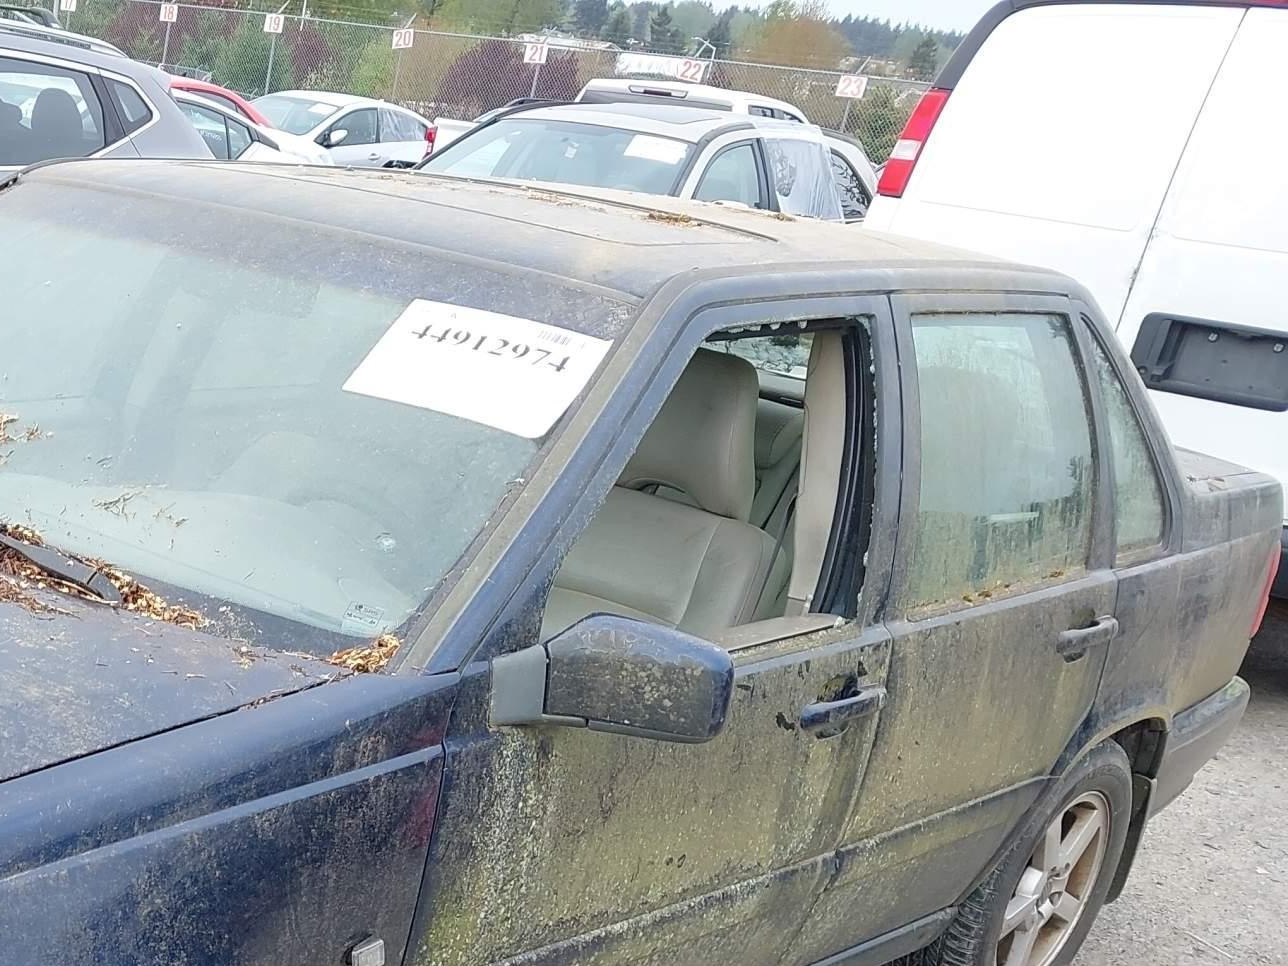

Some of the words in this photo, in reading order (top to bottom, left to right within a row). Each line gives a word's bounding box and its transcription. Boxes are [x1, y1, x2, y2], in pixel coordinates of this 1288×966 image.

[162, 5, 175, 19] 18
[268, 16, 281, 30] 19
[394, 31, 411, 47] 20
[529, 45, 545, 62] 21
[679, 60, 702, 81] 22
[839, 78, 862, 96] 23
[411, 324, 571, 373] 44912974
